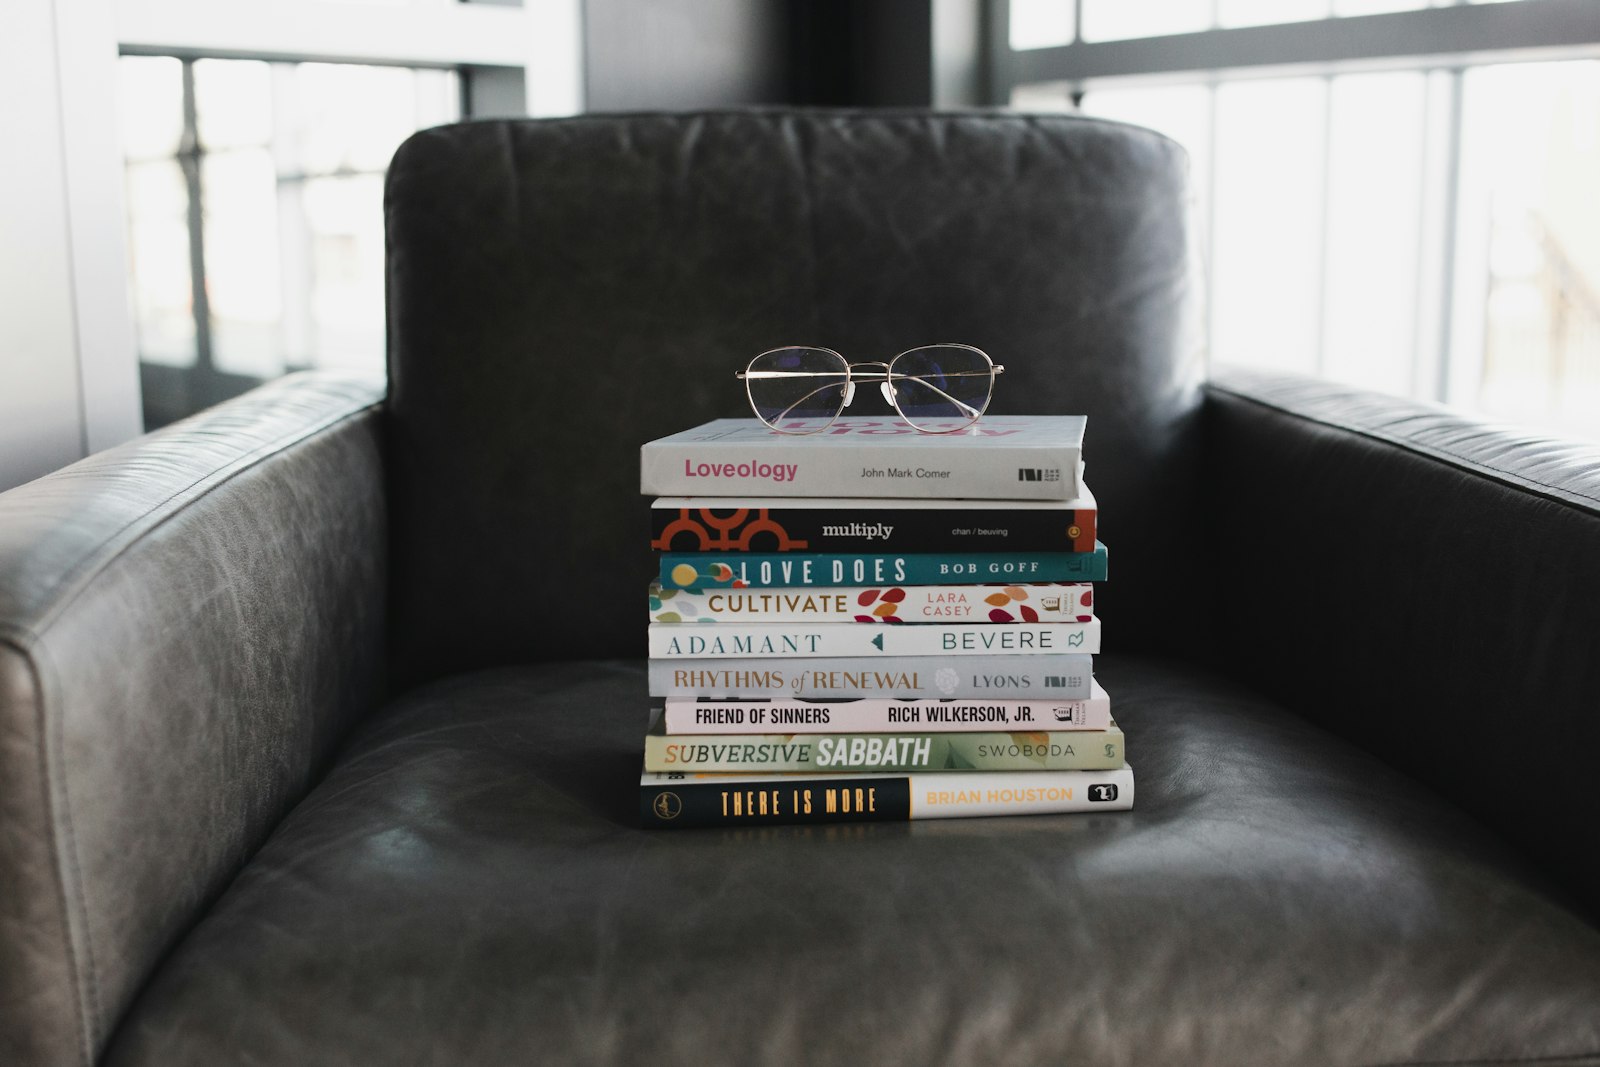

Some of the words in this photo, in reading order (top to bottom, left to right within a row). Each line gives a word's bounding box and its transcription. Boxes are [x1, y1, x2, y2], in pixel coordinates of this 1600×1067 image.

[685, 459, 798, 481] Loveology
[861, 468, 884, 478] John
[888, 468, 913, 478] Mark
[916, 468, 951, 479] Comer
[822, 522, 894, 540] multiply
[952, 528, 971, 536] chan
[978, 527, 1008, 537] beuving
[741, 560, 813, 585] LOVE
[832, 558, 906, 583] DOES
[940, 563, 978, 574] BOB
[989, 562, 1039, 573] GOFF
[708, 594, 848, 613] CULTIVATE
[928, 592, 967, 604] LARA
[922, 606, 972, 616] CASEY
[667, 634, 822, 655] ADAMANT
[943, 631, 1053, 650] BEVERE
[674, 670, 784, 689] RHYTHMS
[791, 670, 810, 694] of
[813, 671, 925, 690] RENEWAL
[973, 674, 1031, 688] LYONS
[696, 708, 744, 724] FRIEND
[750, 708, 766, 724] OF
[770, 708, 830, 724] SINNERS
[888, 706, 920, 722] RICH
[926, 706, 1009, 724] WILKERSON,
[1014, 706, 1035, 722] JR.
[664, 744, 812, 764] SUBVERSIVE
[816, 737, 931, 767] SABBATH
[978, 744, 1076, 758] SWOBODA
[722, 790, 780, 816] THERE
[793, 789, 812, 815] IS
[826, 788, 876, 814] MORE
[926, 791, 981, 805] BRIAN
[986, 788, 1073, 804] HOUSTON
